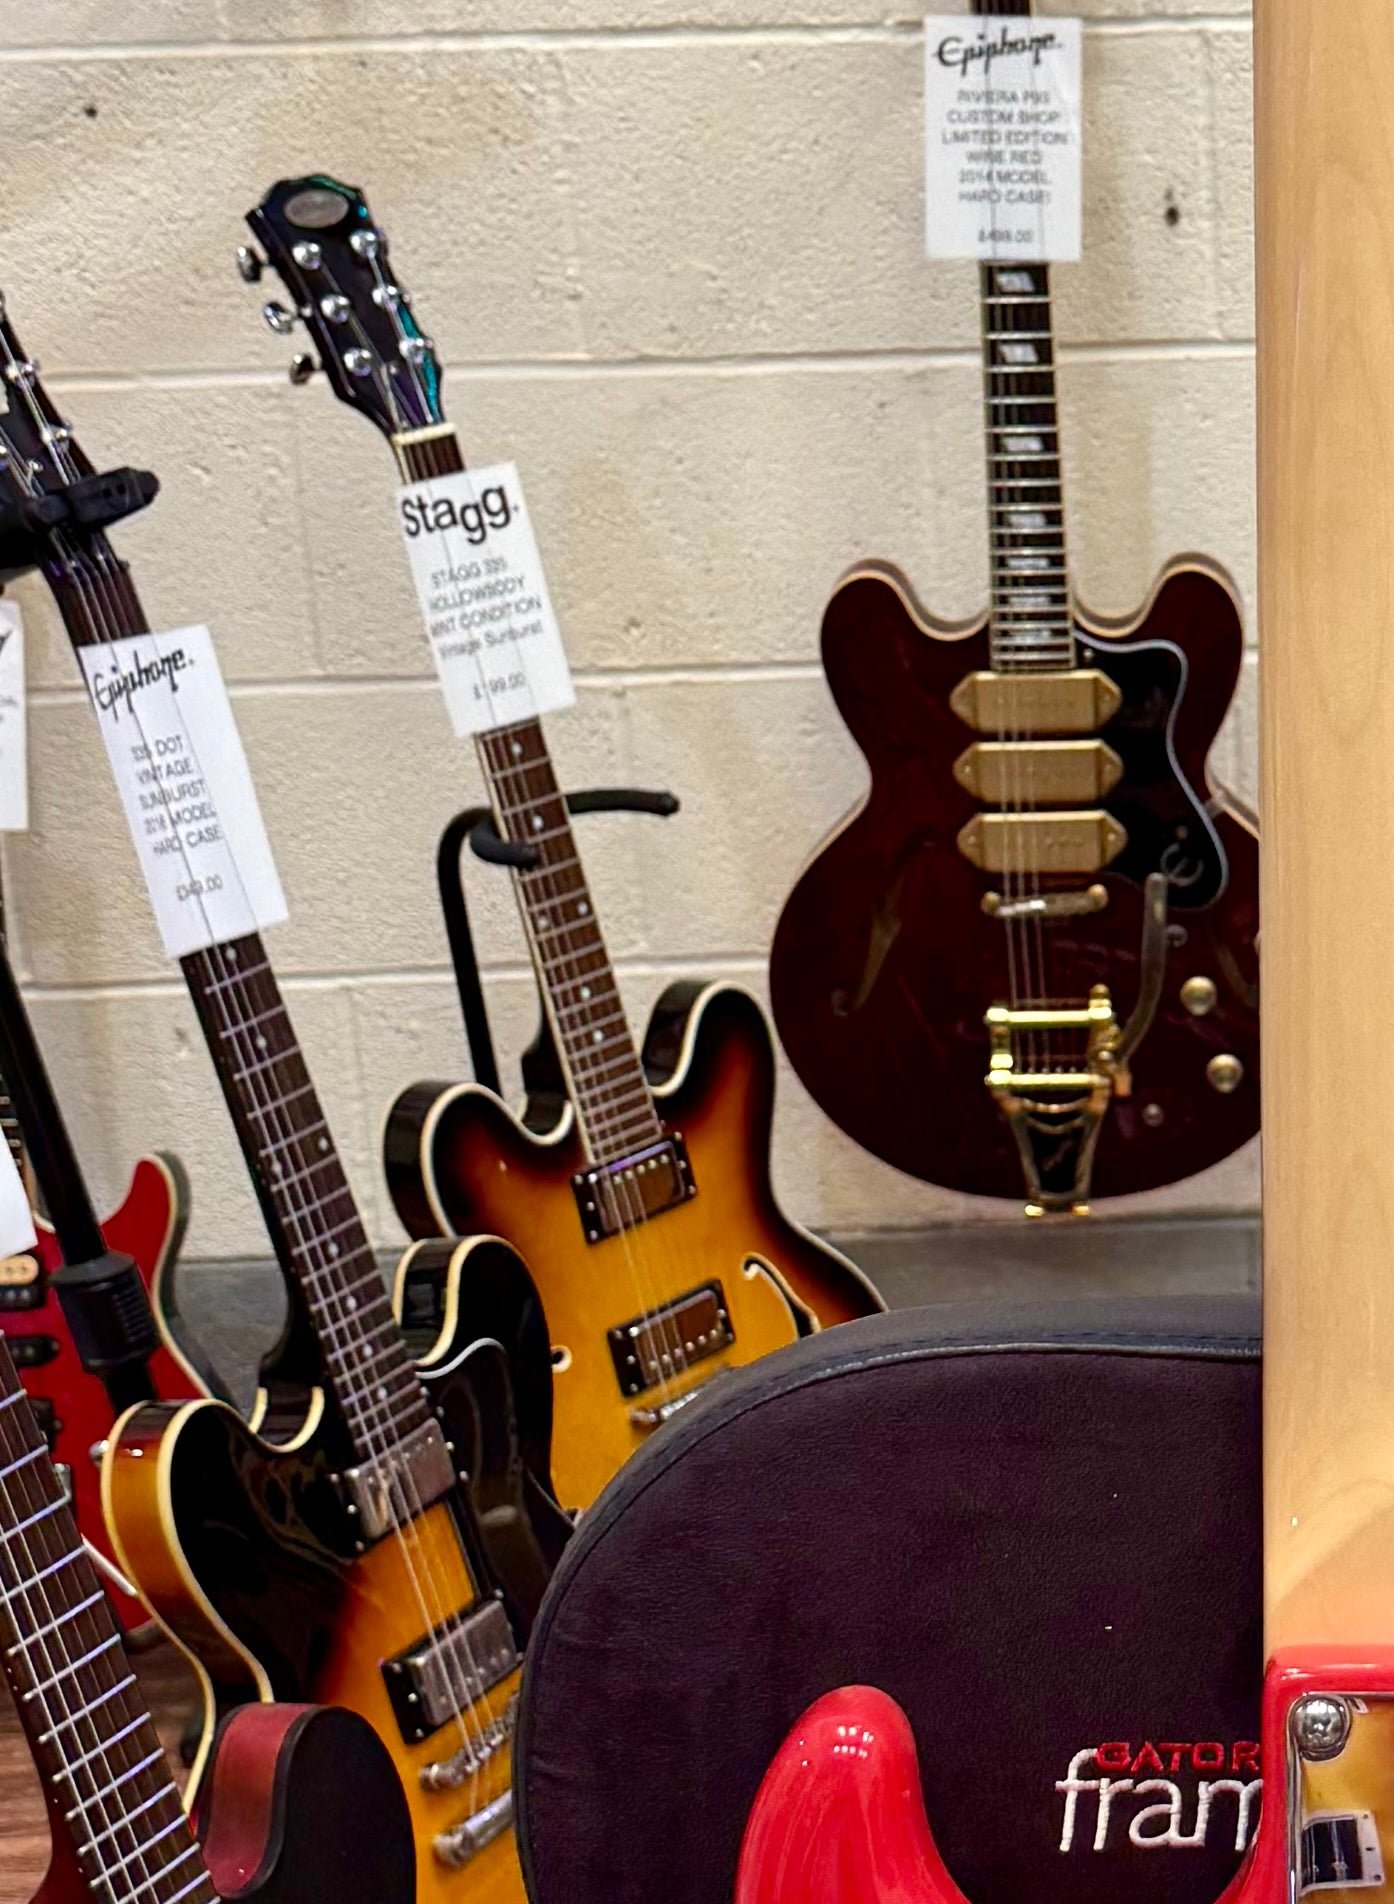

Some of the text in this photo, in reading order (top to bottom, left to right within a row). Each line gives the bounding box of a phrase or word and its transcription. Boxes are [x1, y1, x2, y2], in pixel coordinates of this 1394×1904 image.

[946, 109, 1013, 124] CUSTOM
[154, 735, 184, 758] DOT
[136, 757, 194, 785] VINTAGE
[1095, 1741, 1261, 1773] GATOR
